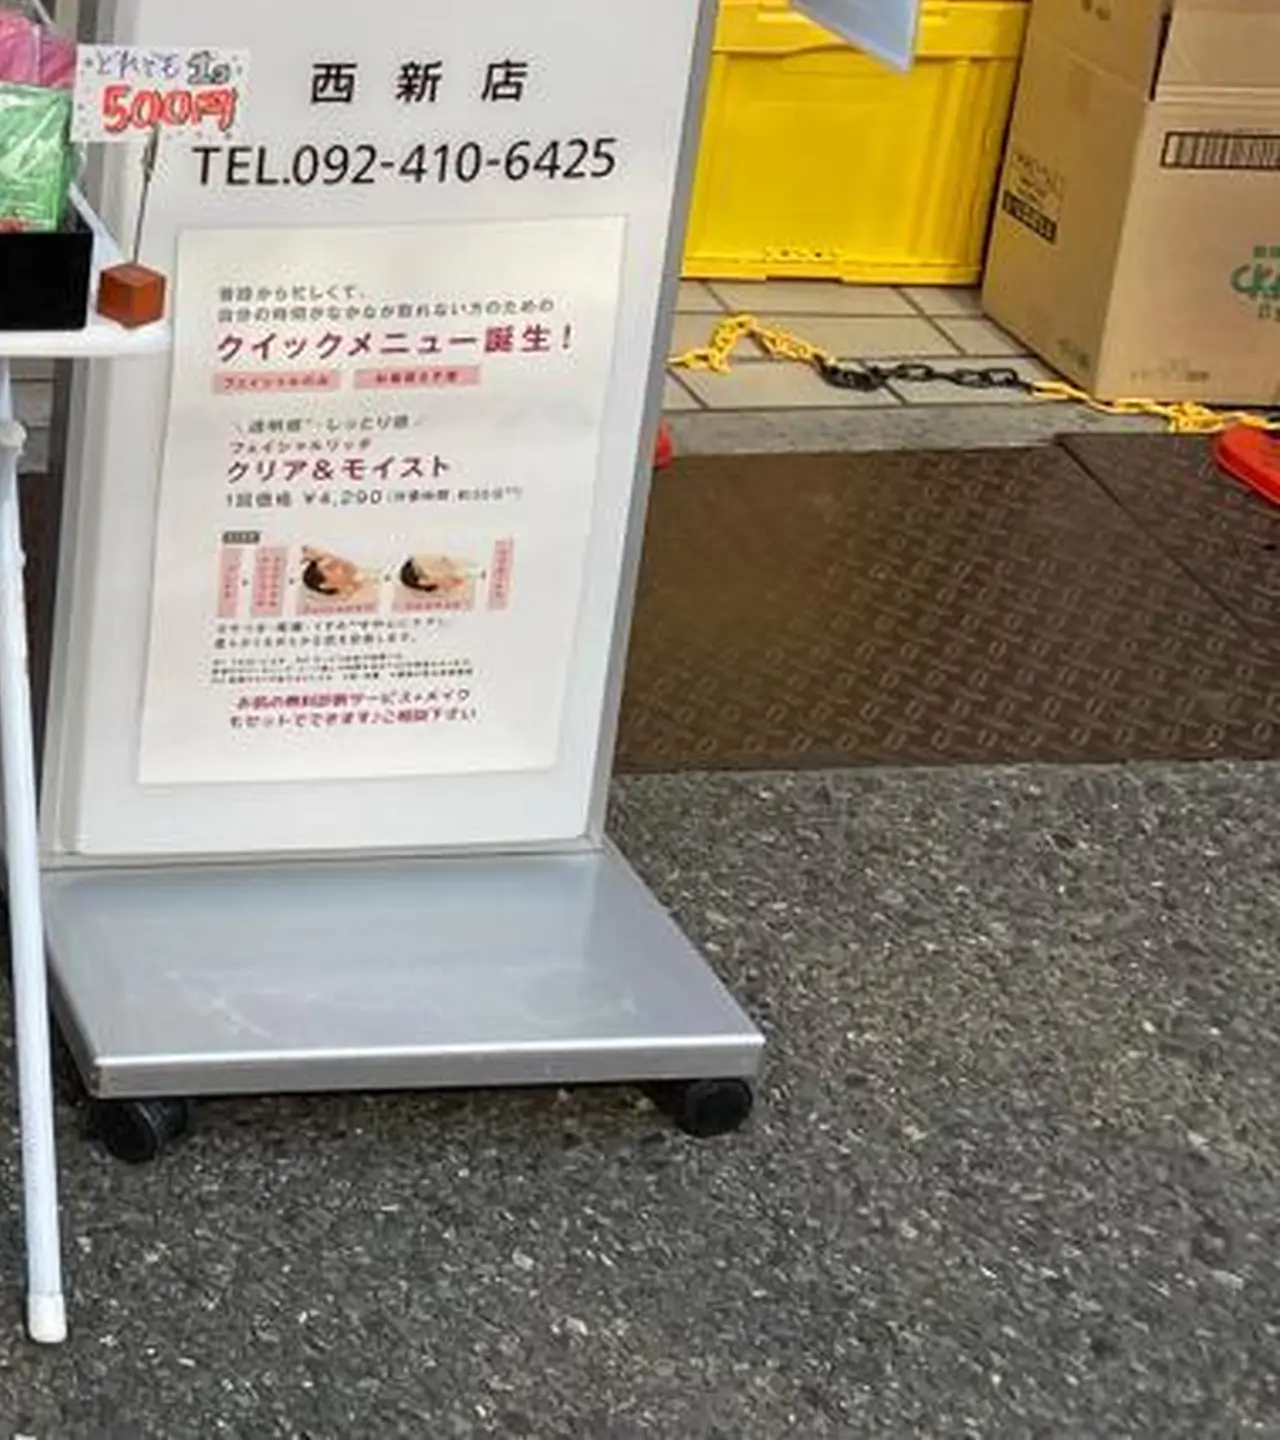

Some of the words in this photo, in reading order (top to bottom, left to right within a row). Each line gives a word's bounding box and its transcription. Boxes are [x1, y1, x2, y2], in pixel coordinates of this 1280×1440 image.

[310, 58, 530, 105] 西新店
[103, 85, 240, 134] 500円
[191, 136, 618, 188] TEL.092-410-6425
